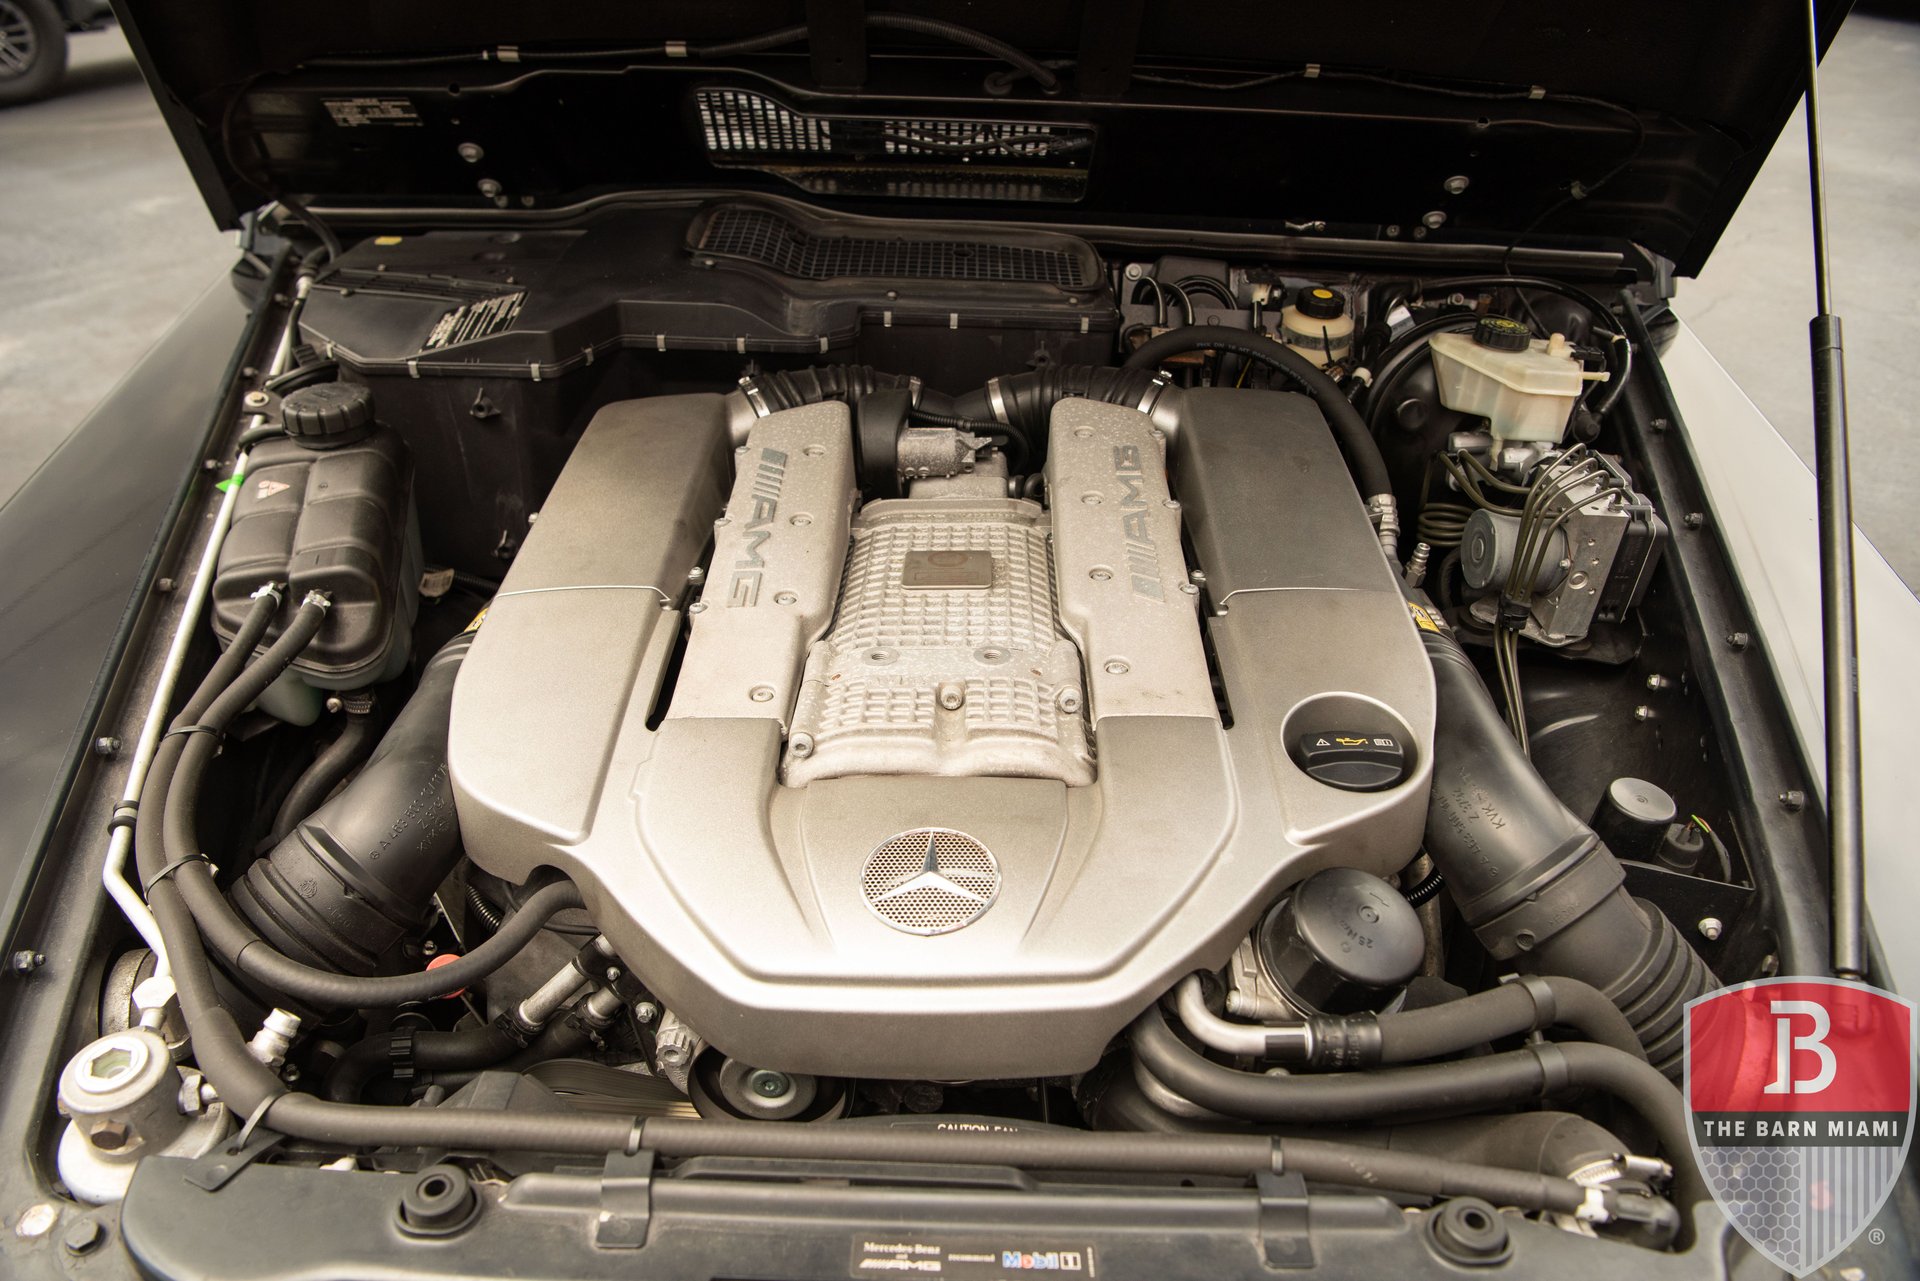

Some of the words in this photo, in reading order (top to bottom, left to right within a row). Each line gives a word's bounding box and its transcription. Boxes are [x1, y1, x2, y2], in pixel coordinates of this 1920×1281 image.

[1113, 445, 1156, 550] AMG
[726, 492, 779, 608] AMG
[863, 1242, 940, 1255] Mercedes-Benz
[1002, 1251, 1060, 1270] Mobil
